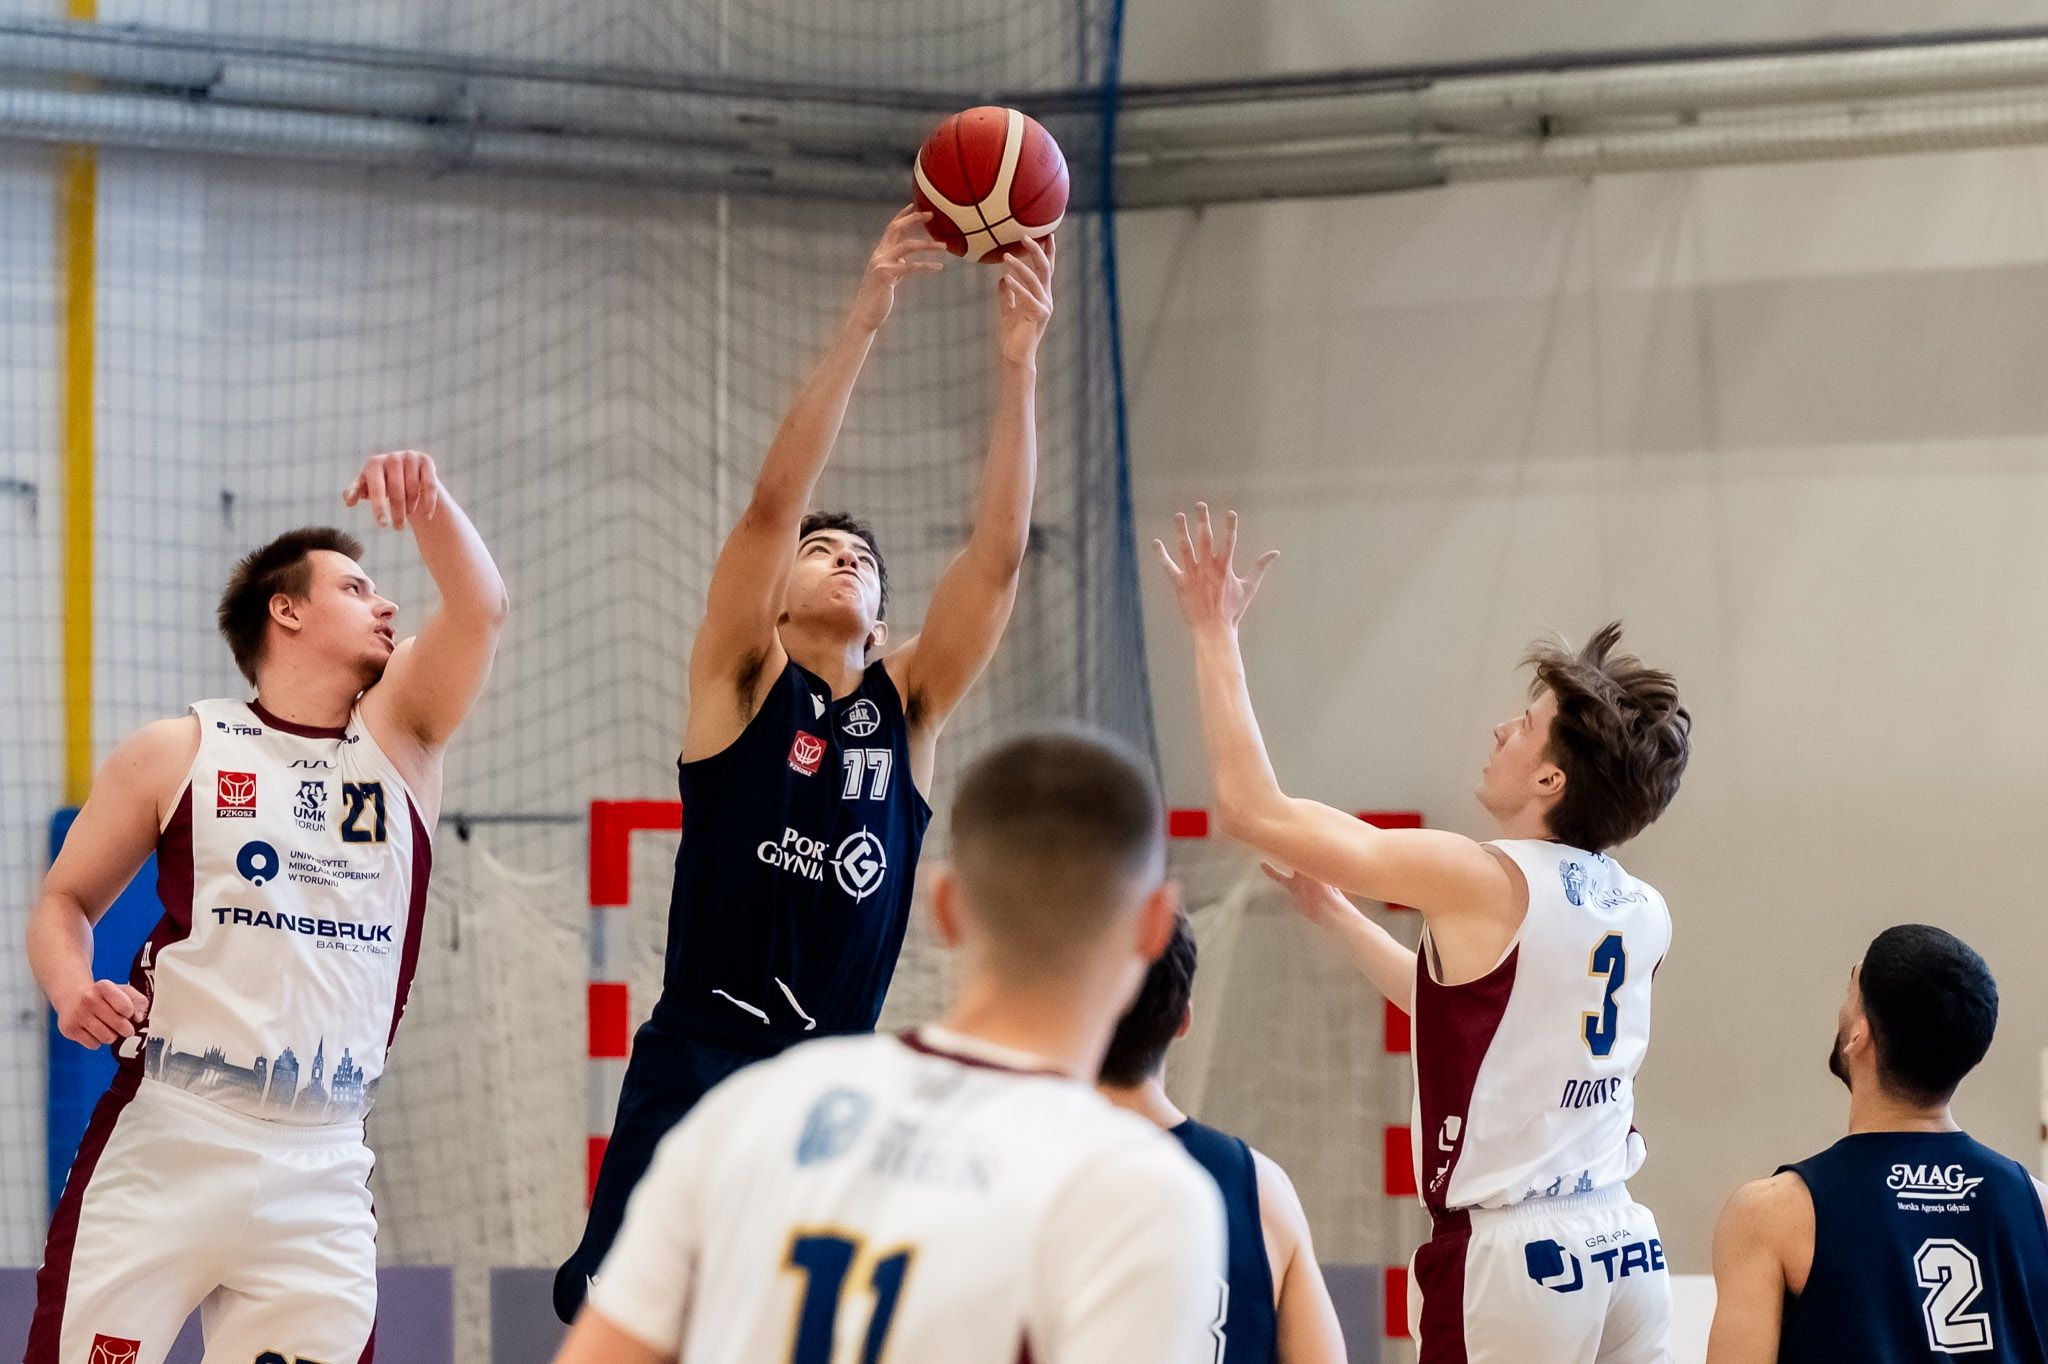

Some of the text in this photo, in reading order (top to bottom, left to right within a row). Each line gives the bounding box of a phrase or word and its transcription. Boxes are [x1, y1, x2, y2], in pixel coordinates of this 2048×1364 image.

[842, 748, 892, 801] 77
[220, 809, 254, 818] PZKOSZ
[294, 806, 326, 821] UMK
[339, 781, 387, 846] 27
[781, 827, 830, 861] POR
[288, 873, 297, 881] W
[211, 907, 393, 942] TRANSBRUK
[1581, 930, 1629, 1060] 3
[1886, 1164, 1966, 1192] MAG
[1897, 1202, 1970, 1214] Morska Agencja Gdynia
[1585, 1229, 1632, 1248] GRPA
[1913, 1238, 1994, 1354] 2
